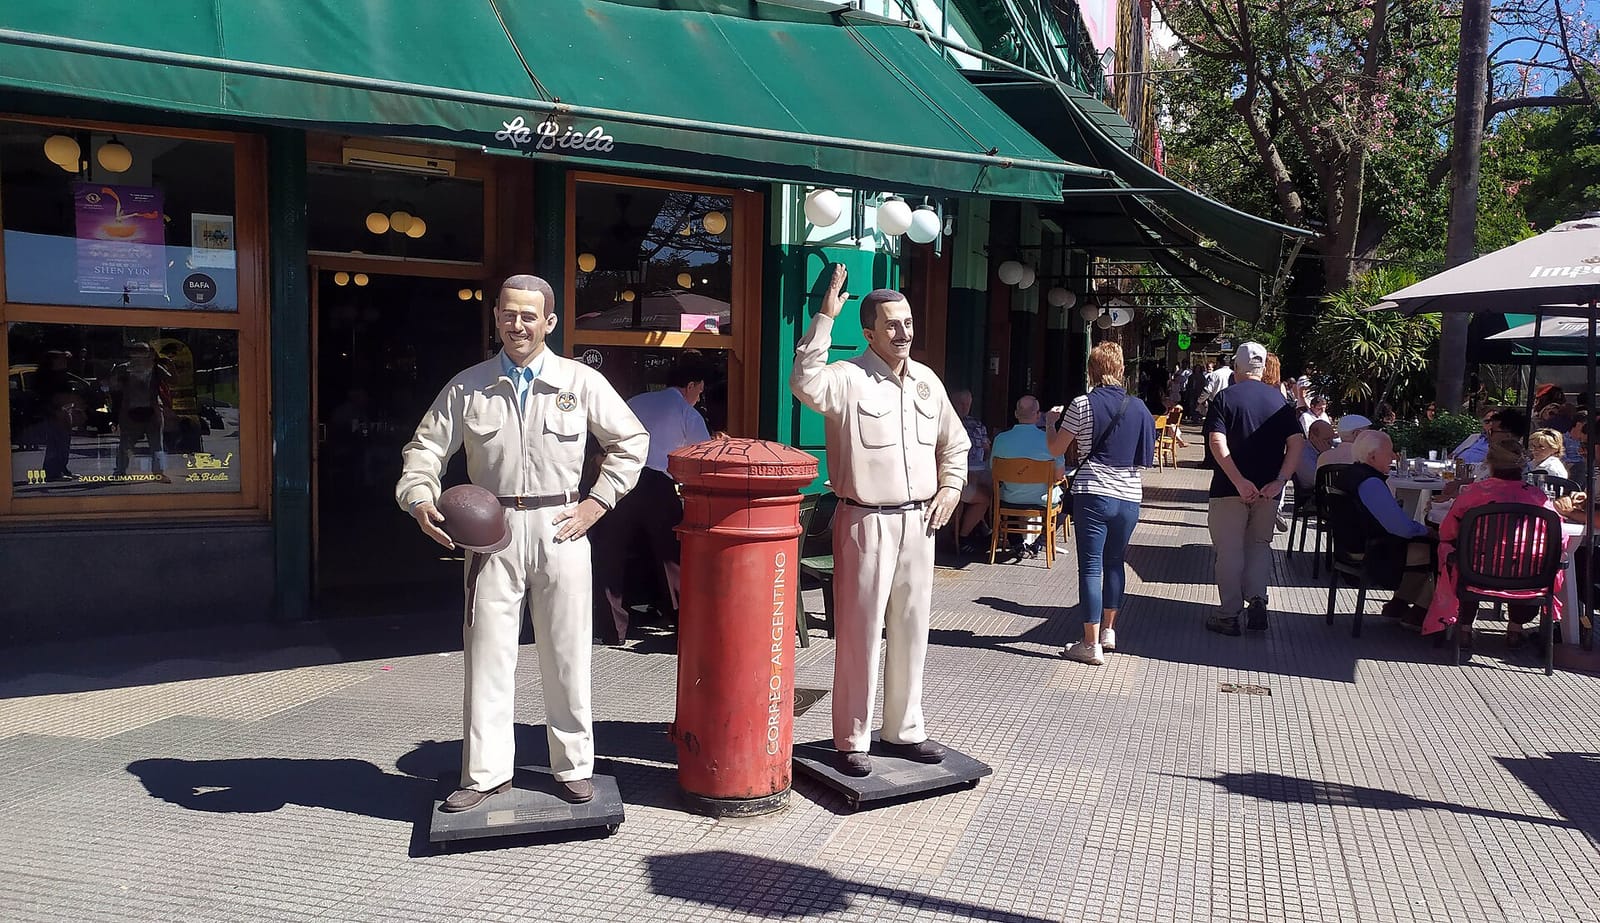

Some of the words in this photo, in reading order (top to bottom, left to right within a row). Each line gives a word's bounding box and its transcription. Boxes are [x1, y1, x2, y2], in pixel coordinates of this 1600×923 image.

[495, 116, 532, 148] La
[536, 120, 615, 153] Biela
[94, 265, 124, 275] SHEN
[127, 267, 150, 276] YUN
[189, 281, 210, 289] BAFA
[107, 474, 163, 482] CLIMATIZADO
[186, 472, 201, 482] La
[201, 472, 229, 481] Biela
[771, 551, 786, 666] ARGENTINO
[766, 675, 781, 755] CORREO
